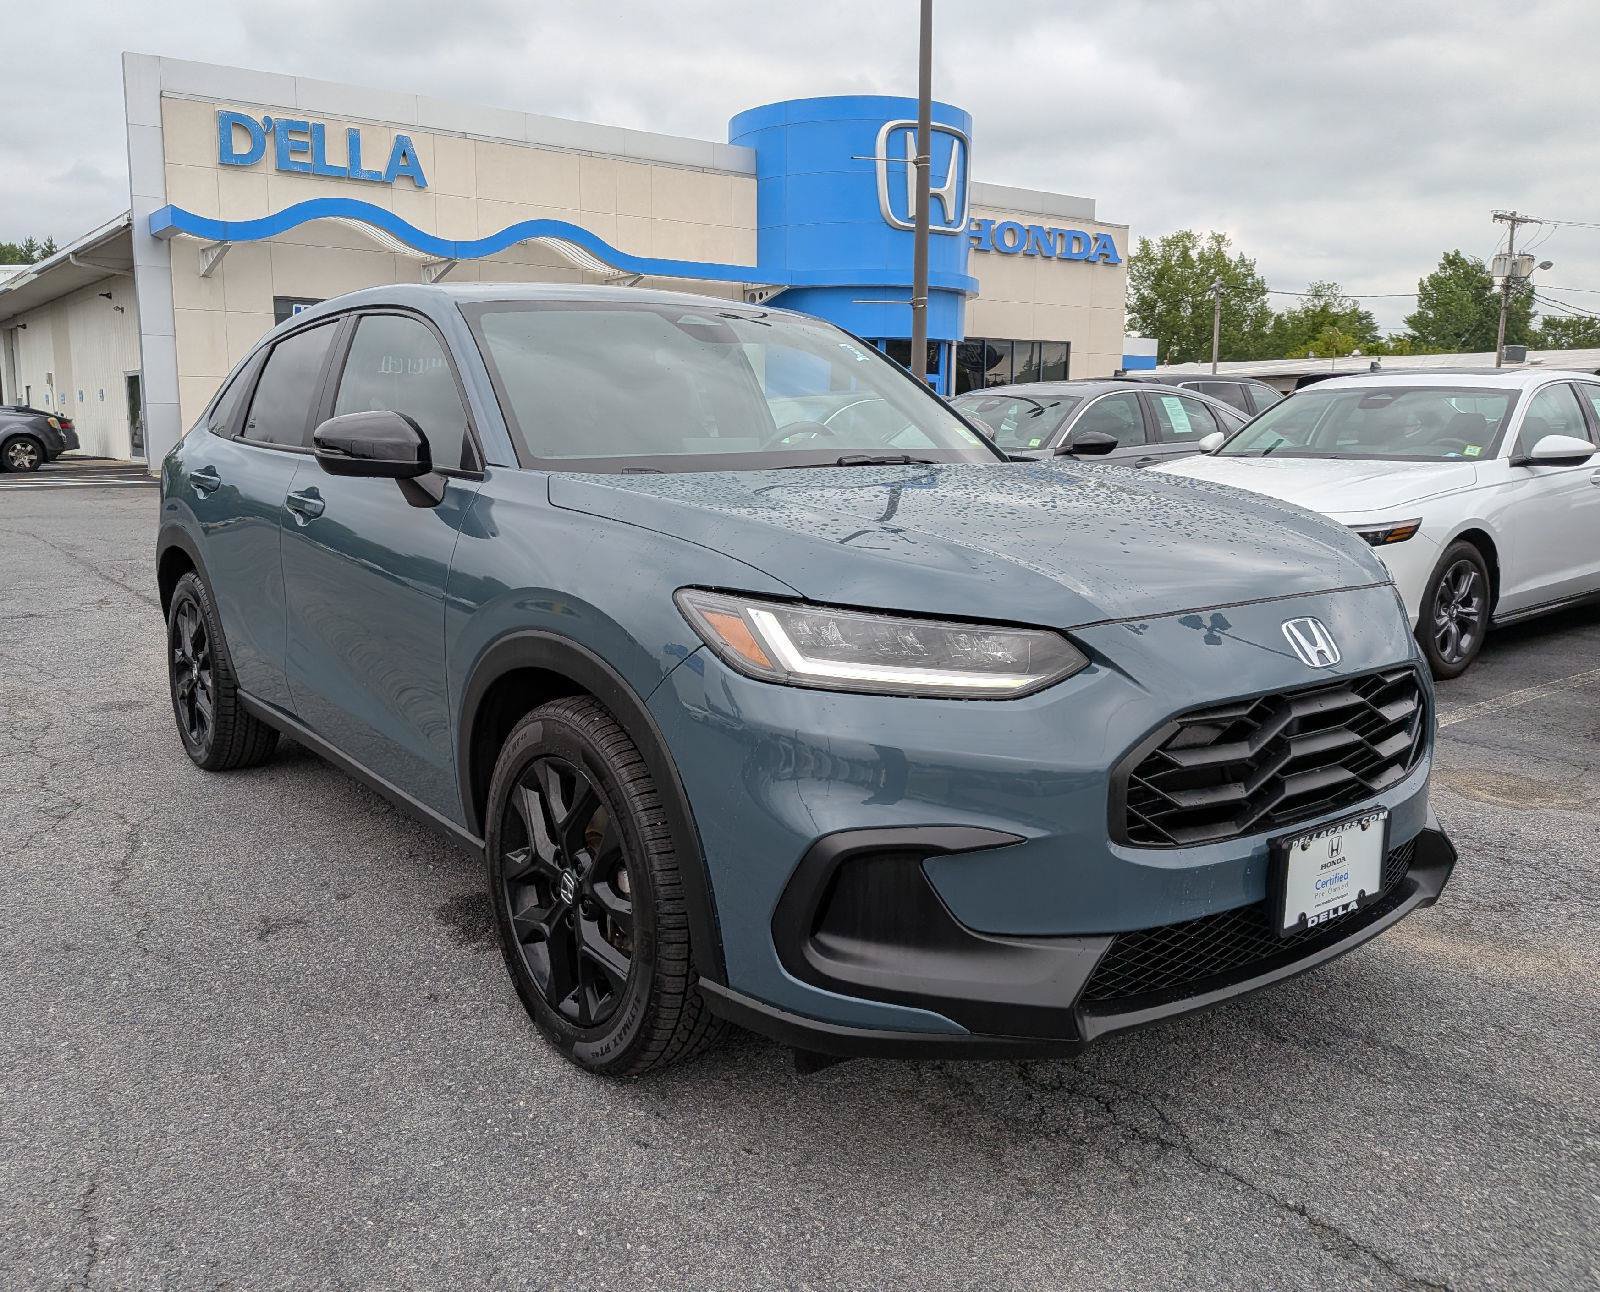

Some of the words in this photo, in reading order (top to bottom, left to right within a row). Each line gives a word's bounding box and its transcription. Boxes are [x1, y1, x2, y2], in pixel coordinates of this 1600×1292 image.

[217, 109, 429, 189] D'ELLA
[968, 217, 1123, 264] HONDA
[1320, 856, 1347, 871] HONDA
[1315, 871, 1349, 891] Certified
[1308, 900, 1359, 928] DELLA
